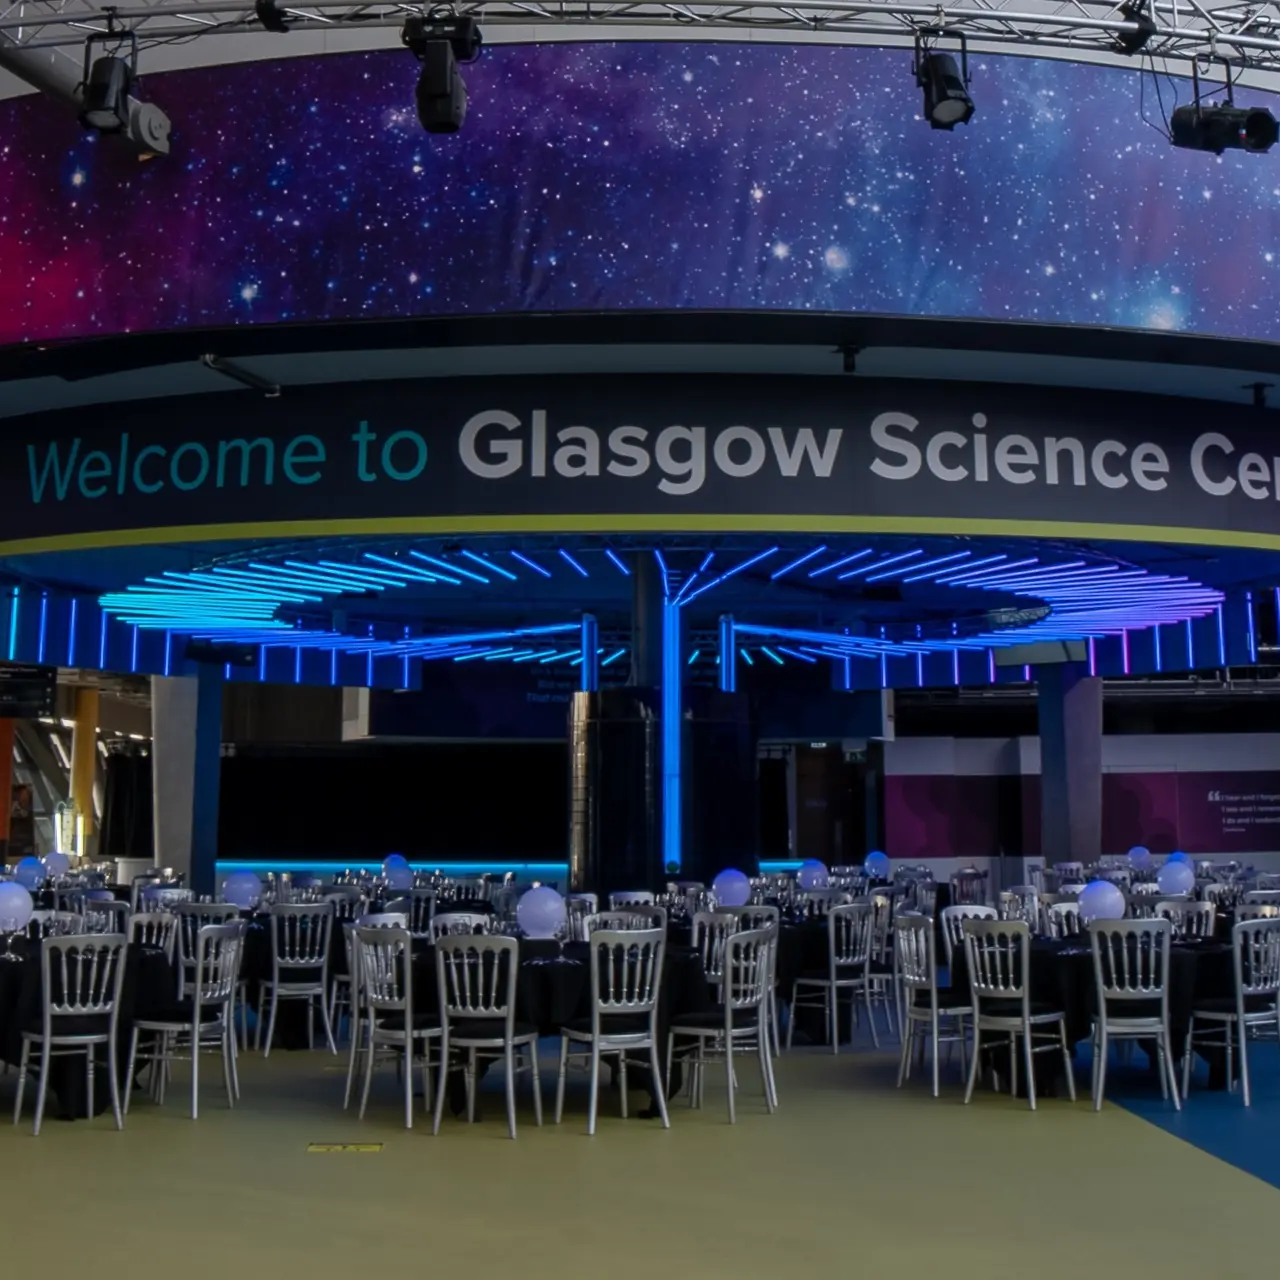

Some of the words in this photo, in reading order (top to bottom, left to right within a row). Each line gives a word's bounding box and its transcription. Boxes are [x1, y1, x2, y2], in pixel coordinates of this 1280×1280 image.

[26, 432, 326, 504] Welcome
[352, 420, 428, 482] to
[458, 409, 844, 496] Glasgow
[868, 411, 1171, 493] Science
